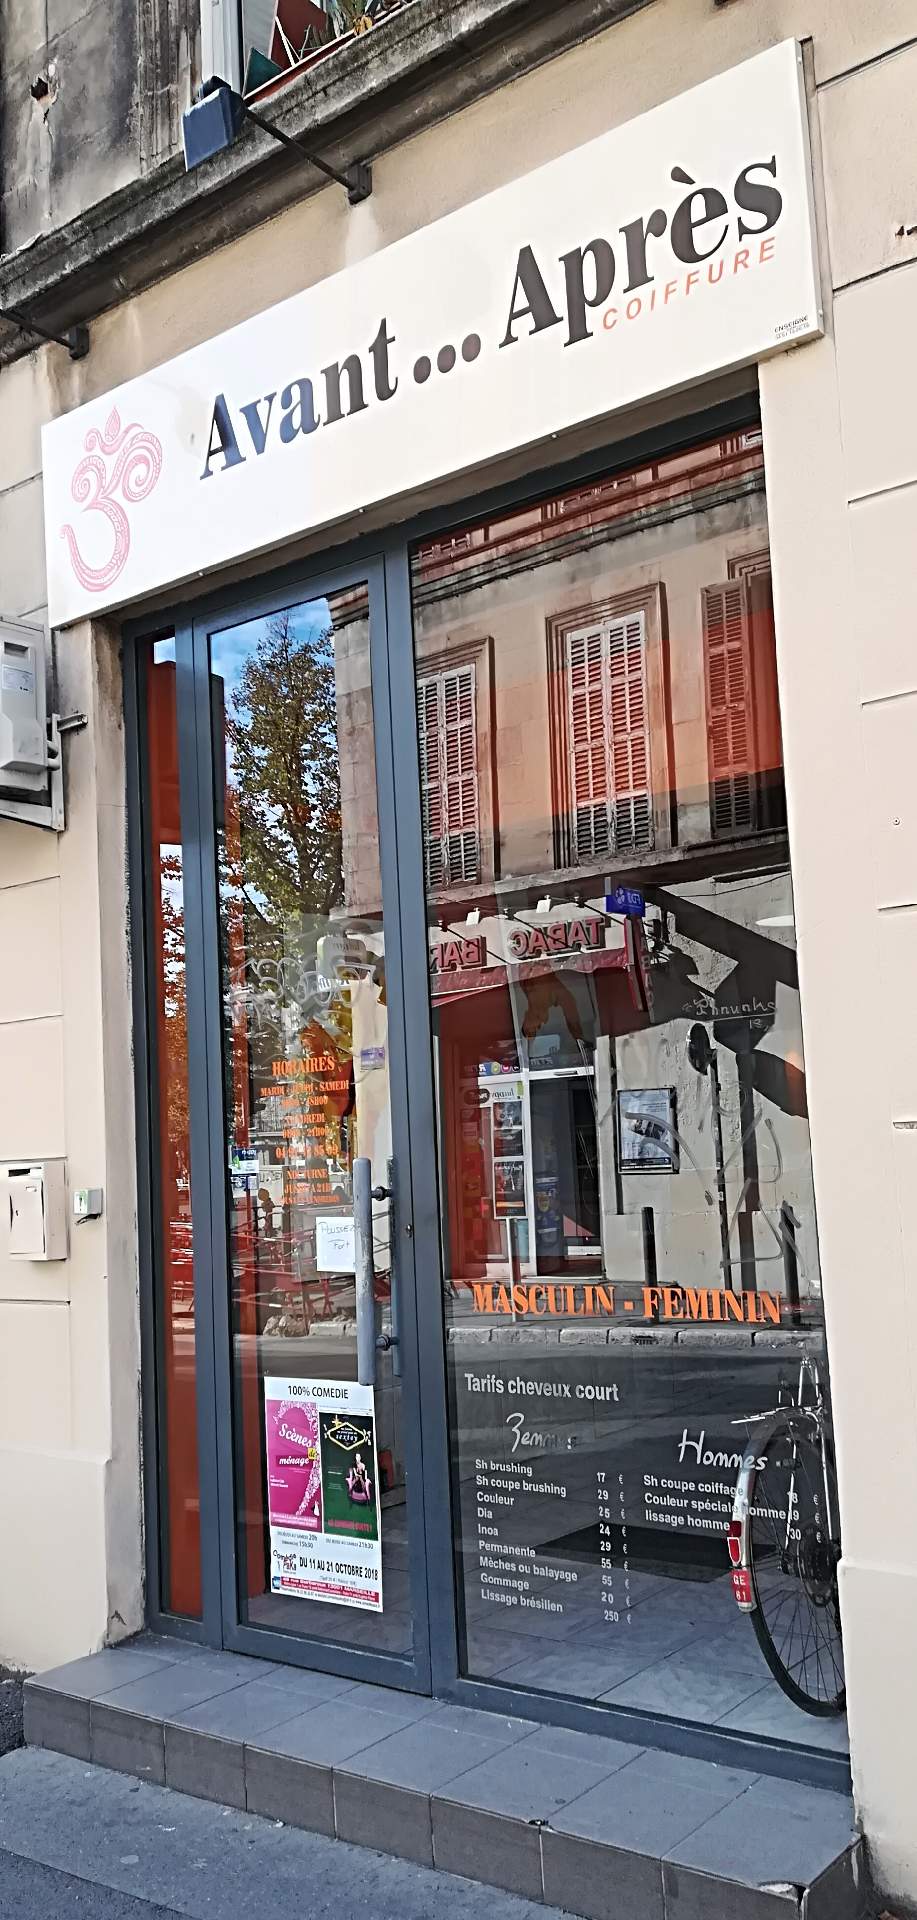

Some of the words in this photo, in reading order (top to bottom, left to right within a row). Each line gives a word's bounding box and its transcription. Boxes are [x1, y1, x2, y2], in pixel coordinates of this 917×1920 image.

[602, 236, 776, 330] COIFFURE
[200, 317, 398, 479] Avant
[499, 155, 783, 347] Après
[272, 1056, 335, 1077] HORAIRES
[320, 1080, 349, 1092] SAMEDI
[473, 1284, 615, 1316] MASCULIN
[642, 1287, 781, 1323] FEMININ
[288, 1385, 310, 1396] 100%
[312, 1387, 349, 1399] COMEDIE
[464, 1373, 504, 1394] Tarifs
[508, 1376, 572, 1398] cheveux
[576, 1383, 619, 1401] court
[279, 1424, 312, 1447] Scènes
[678, 1429, 768, 1470] Hommes
[279, 1456, 309, 1468] ménage
[475, 1458, 488, 1469] Sh
[490, 1461, 533, 1476] brushing
[597, 1472, 606, 1483] 17
[476, 1475, 489, 1486] Sh
[491, 1479, 521, 1491] coupe
[523, 1481, 567, 1497] brushing
[598, 1489, 609, 1500] 29
[643, 1475, 658, 1487] Sh
[661, 1479, 695, 1492] coupe
[698, 1481, 743, 1498] coiffage
[476, 1491, 514, 1505] Couleur
[599, 1506, 610, 1518] 25
[644, 1493, 688, 1507] Couleur
[691, 1499, 739, 1513] spéciale
[746, 1505, 786, 1520] omme
[477, 1507, 493, 1519] Dia
[600, 1524, 611, 1536] 24
[645, 1509, 684, 1526] lissage
[687, 1515, 730, 1531] homme
[789, 1528, 801, 1541] 30
[478, 1523, 499, 1536] Inoa
[600, 1541, 612, 1552] 29
[478, 1540, 536, 1558] Permanente
[601, 1558, 612, 1569] 55
[299, 1557, 308, 1568] DU
[309, 1558, 316, 1570] 11
[317, 1559, 325, 1571] AU
[326, 1561, 334, 1573] 21
[335, 1562, 363, 1577] OCTOBRE
[364, 1567, 379, 1581] 2018
[479, 1556, 516, 1572] Mèches
[518, 1564, 531, 1573] ou
[533, 1564, 578, 1581] balayage
[602, 1575, 613, 1586] 55
[480, 1573, 530, 1591] Gommage
[601, 1592, 614, 1604] 20
[481, 1589, 518, 1606] Lissage
[520, 1595, 563, 1612] brésilien
[604, 1610, 619, 1622] 250
